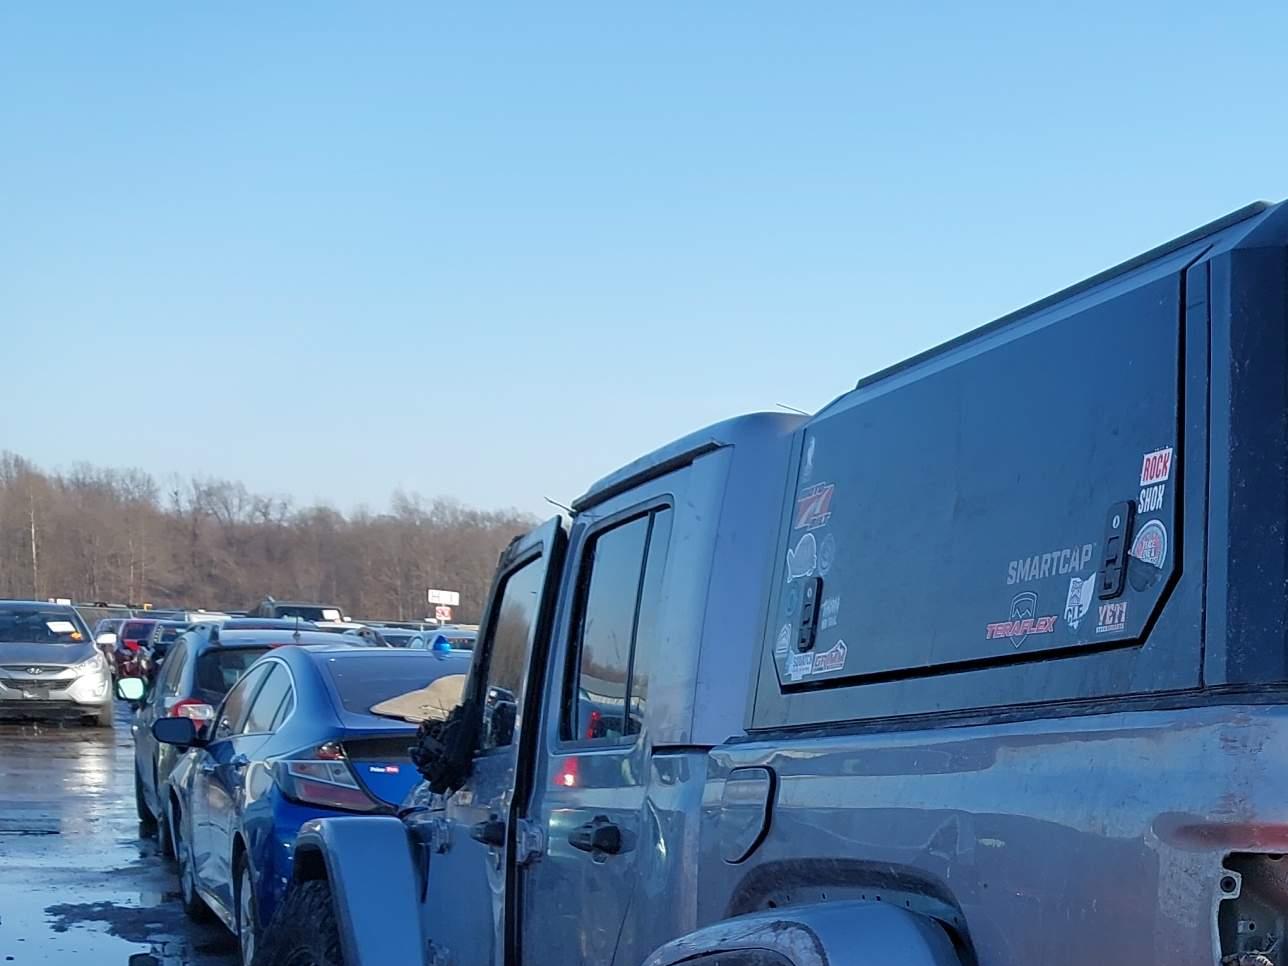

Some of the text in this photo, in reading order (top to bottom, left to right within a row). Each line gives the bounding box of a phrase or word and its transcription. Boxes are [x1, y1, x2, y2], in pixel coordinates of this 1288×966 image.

[1143, 452, 1170, 482] ROCK
[1138, 484, 1165, 514] SHOX
[1006, 543, 1093, 585] SMARTCAP
[986, 616, 1057, 640] TERAFLEX
[1098, 602, 1128, 626] YETI
